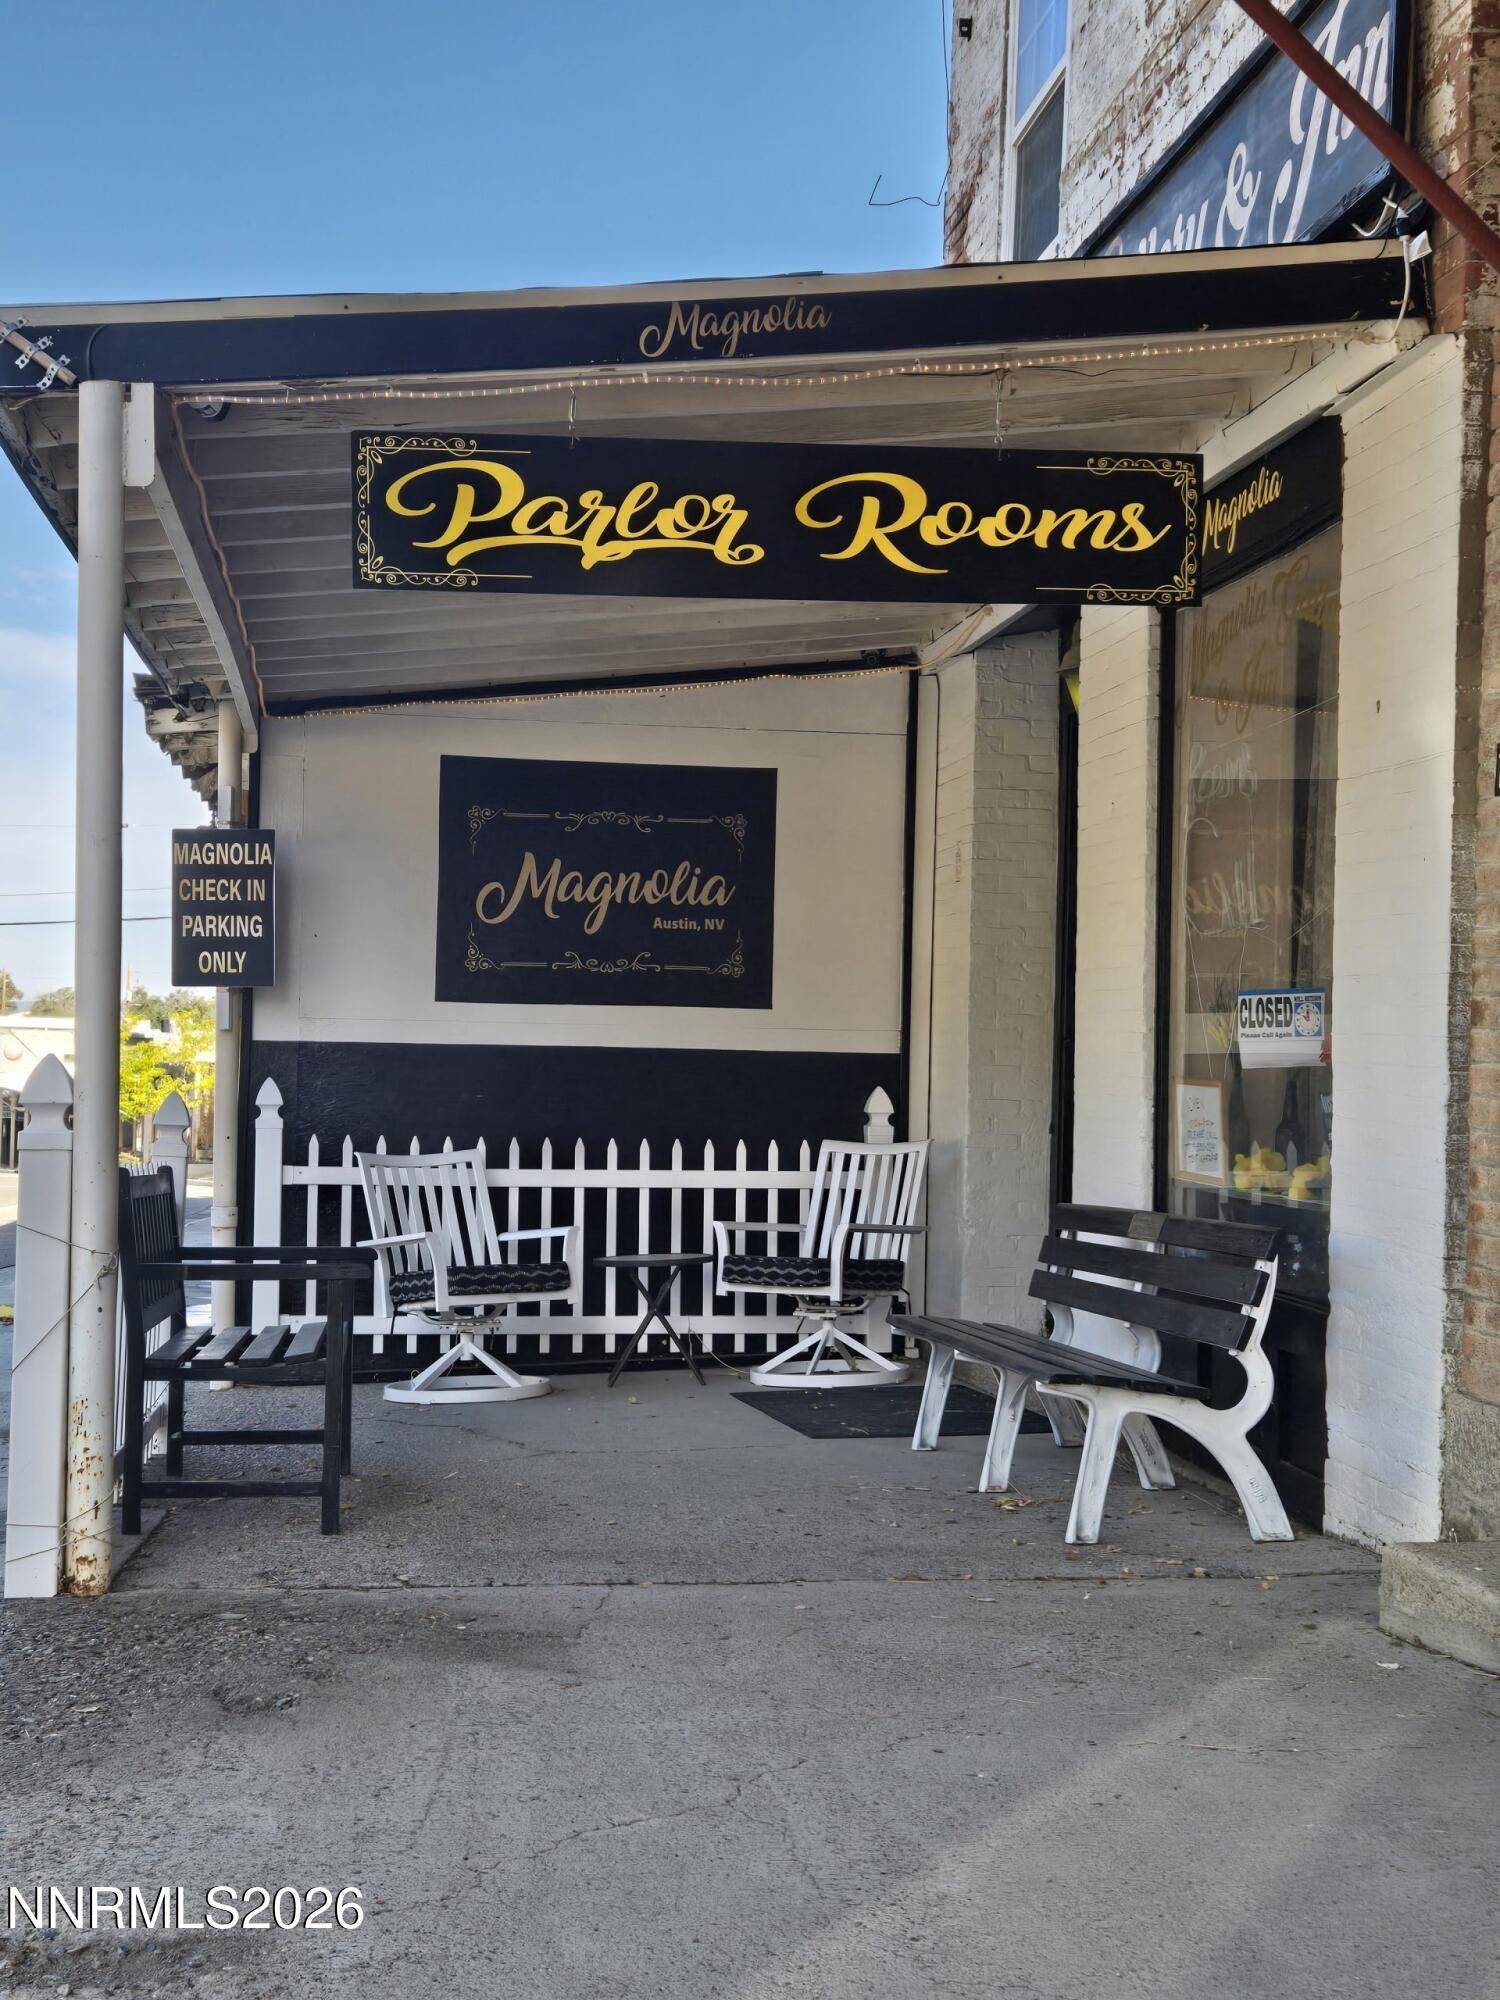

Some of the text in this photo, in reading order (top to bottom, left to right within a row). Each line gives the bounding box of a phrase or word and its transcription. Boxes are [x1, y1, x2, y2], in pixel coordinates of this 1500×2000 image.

[639, 296, 832, 357] Magnolia
[385, 459, 1172, 575] Parlor Rooms
[1202, 466, 1283, 557] Magnolia
[174, 842, 273, 865] MAGNOLIA
[179, 879, 266, 901] CHECK IN
[475, 851, 736, 935] Magnolia
[182, 915, 263, 938] PARKING
[653, 917, 725, 932] Austin, NV
[198, 951, 247, 974] ONLY
[1239, 996, 1293, 1029] CLOSED
